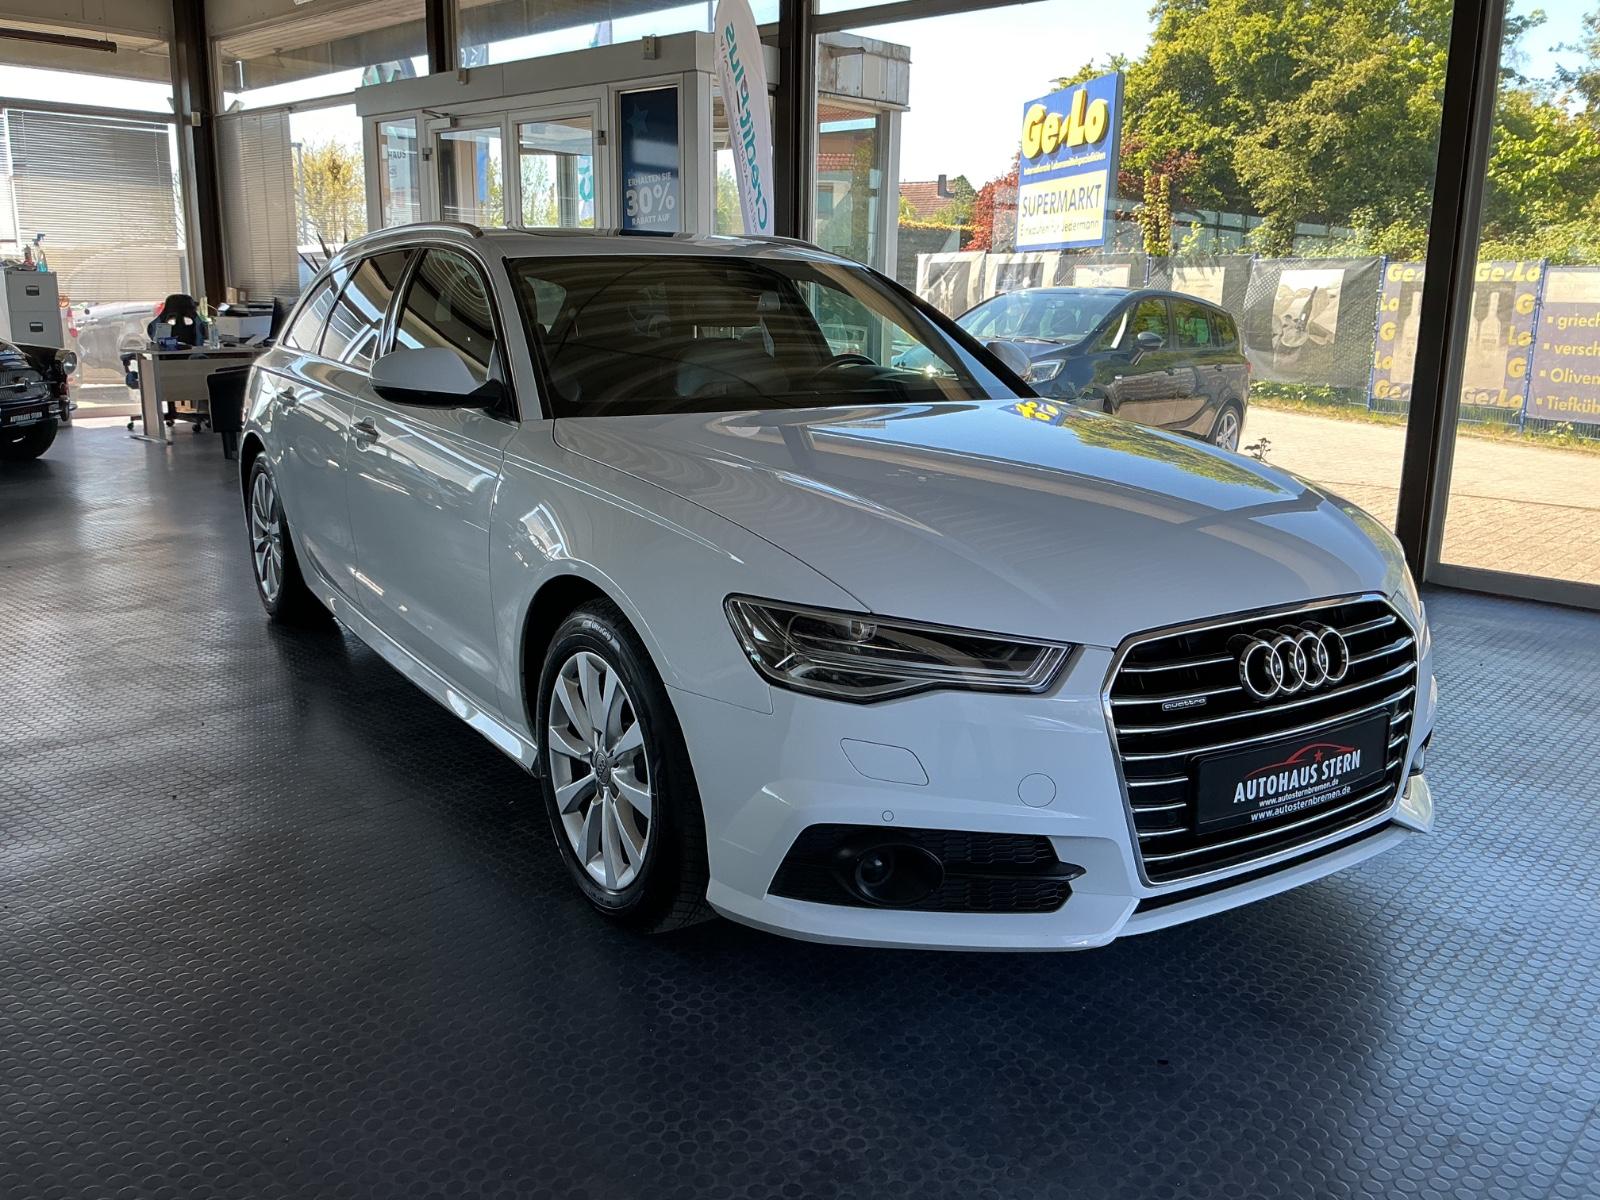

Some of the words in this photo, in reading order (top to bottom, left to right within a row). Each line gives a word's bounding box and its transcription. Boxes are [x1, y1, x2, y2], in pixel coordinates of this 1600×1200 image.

[627, 174, 661, 187] ERHALTEN
[661, 171, 672, 182] SIE
[625, 182, 675, 217] 30%
[1022, 184, 1102, 218] SUPERMARKT
[631, 214, 657, 226] RABATT
[657, 213, 671, 224] AUF
[1554, 340, 1600, 357] versch
[592, 621, 612, 641] UltraGrip
[1163, 697, 1207, 711] quattro
[1233, 763, 1318, 804] AUTOHAUS
[1321, 749, 1361, 781] STERN
[1250, 785, 1351, 822] www.autosternbremen.de
[1258, 778, 1339, 807] www.autosternbremen.de
